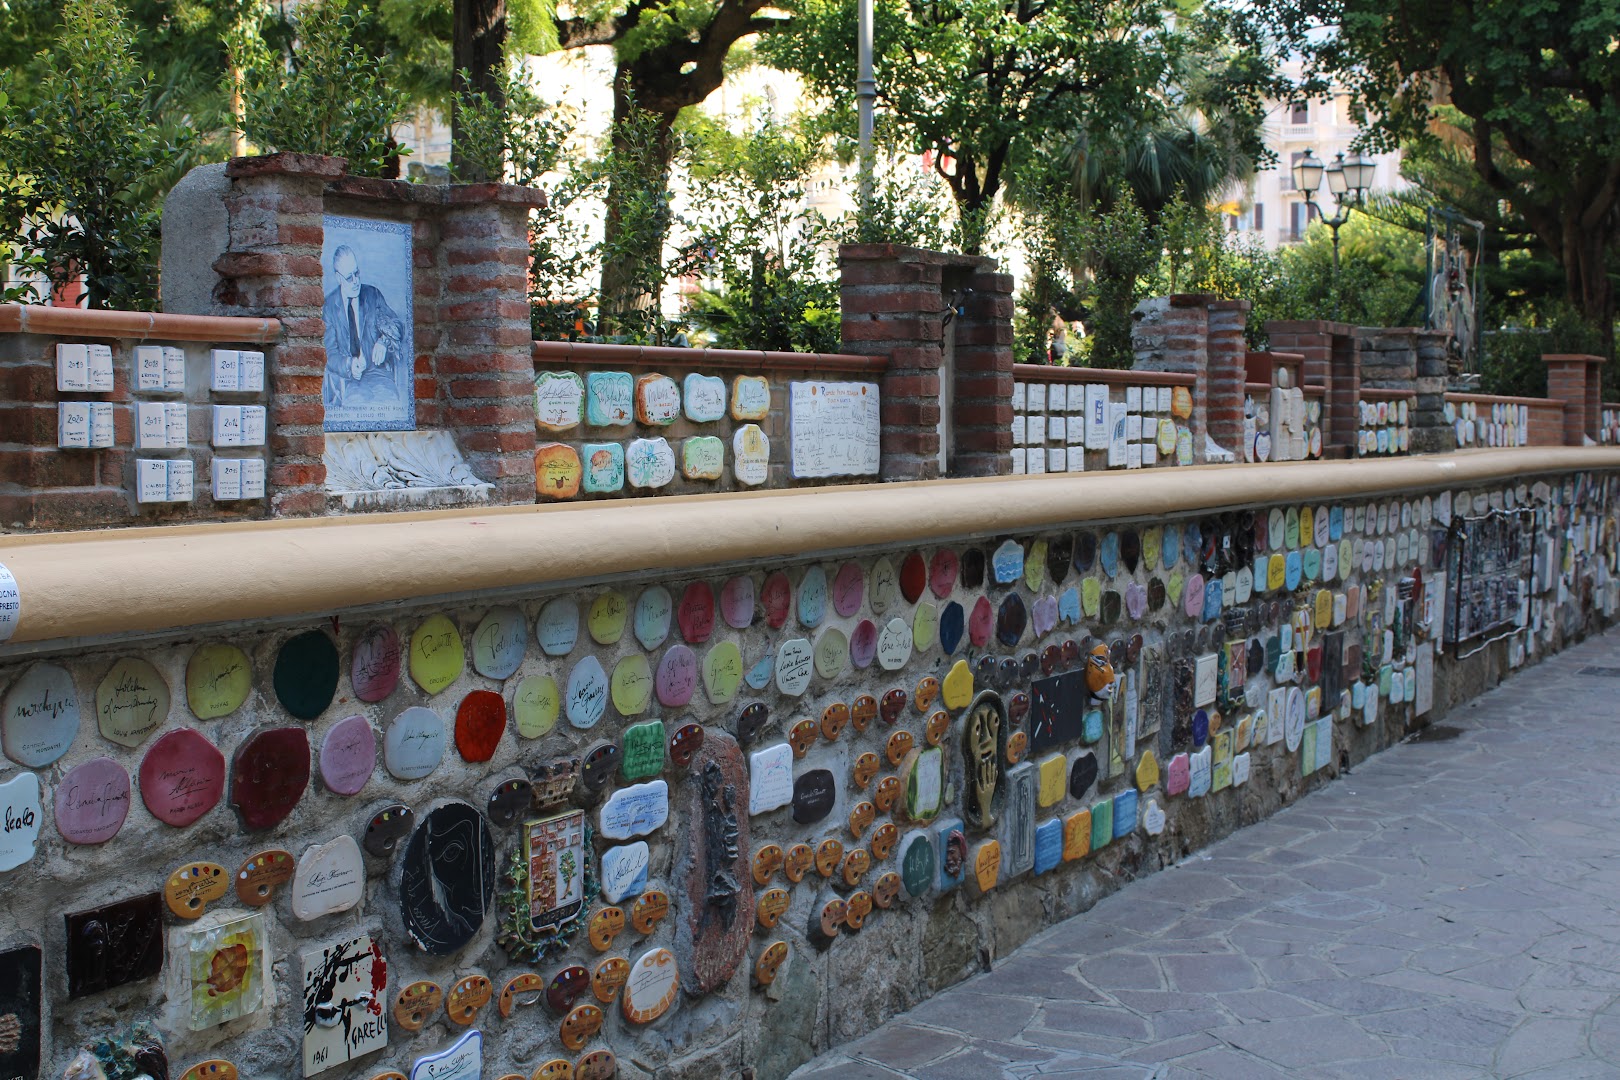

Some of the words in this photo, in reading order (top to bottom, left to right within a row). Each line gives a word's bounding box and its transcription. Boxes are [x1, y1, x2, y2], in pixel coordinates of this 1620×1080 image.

[68, 361, 83, 369] 2019
[144, 359, 158, 368] 2018
[67, 414, 84, 424] 2020
[145, 416, 161, 426] 2017
[313, 1046, 329, 1065] 1961
